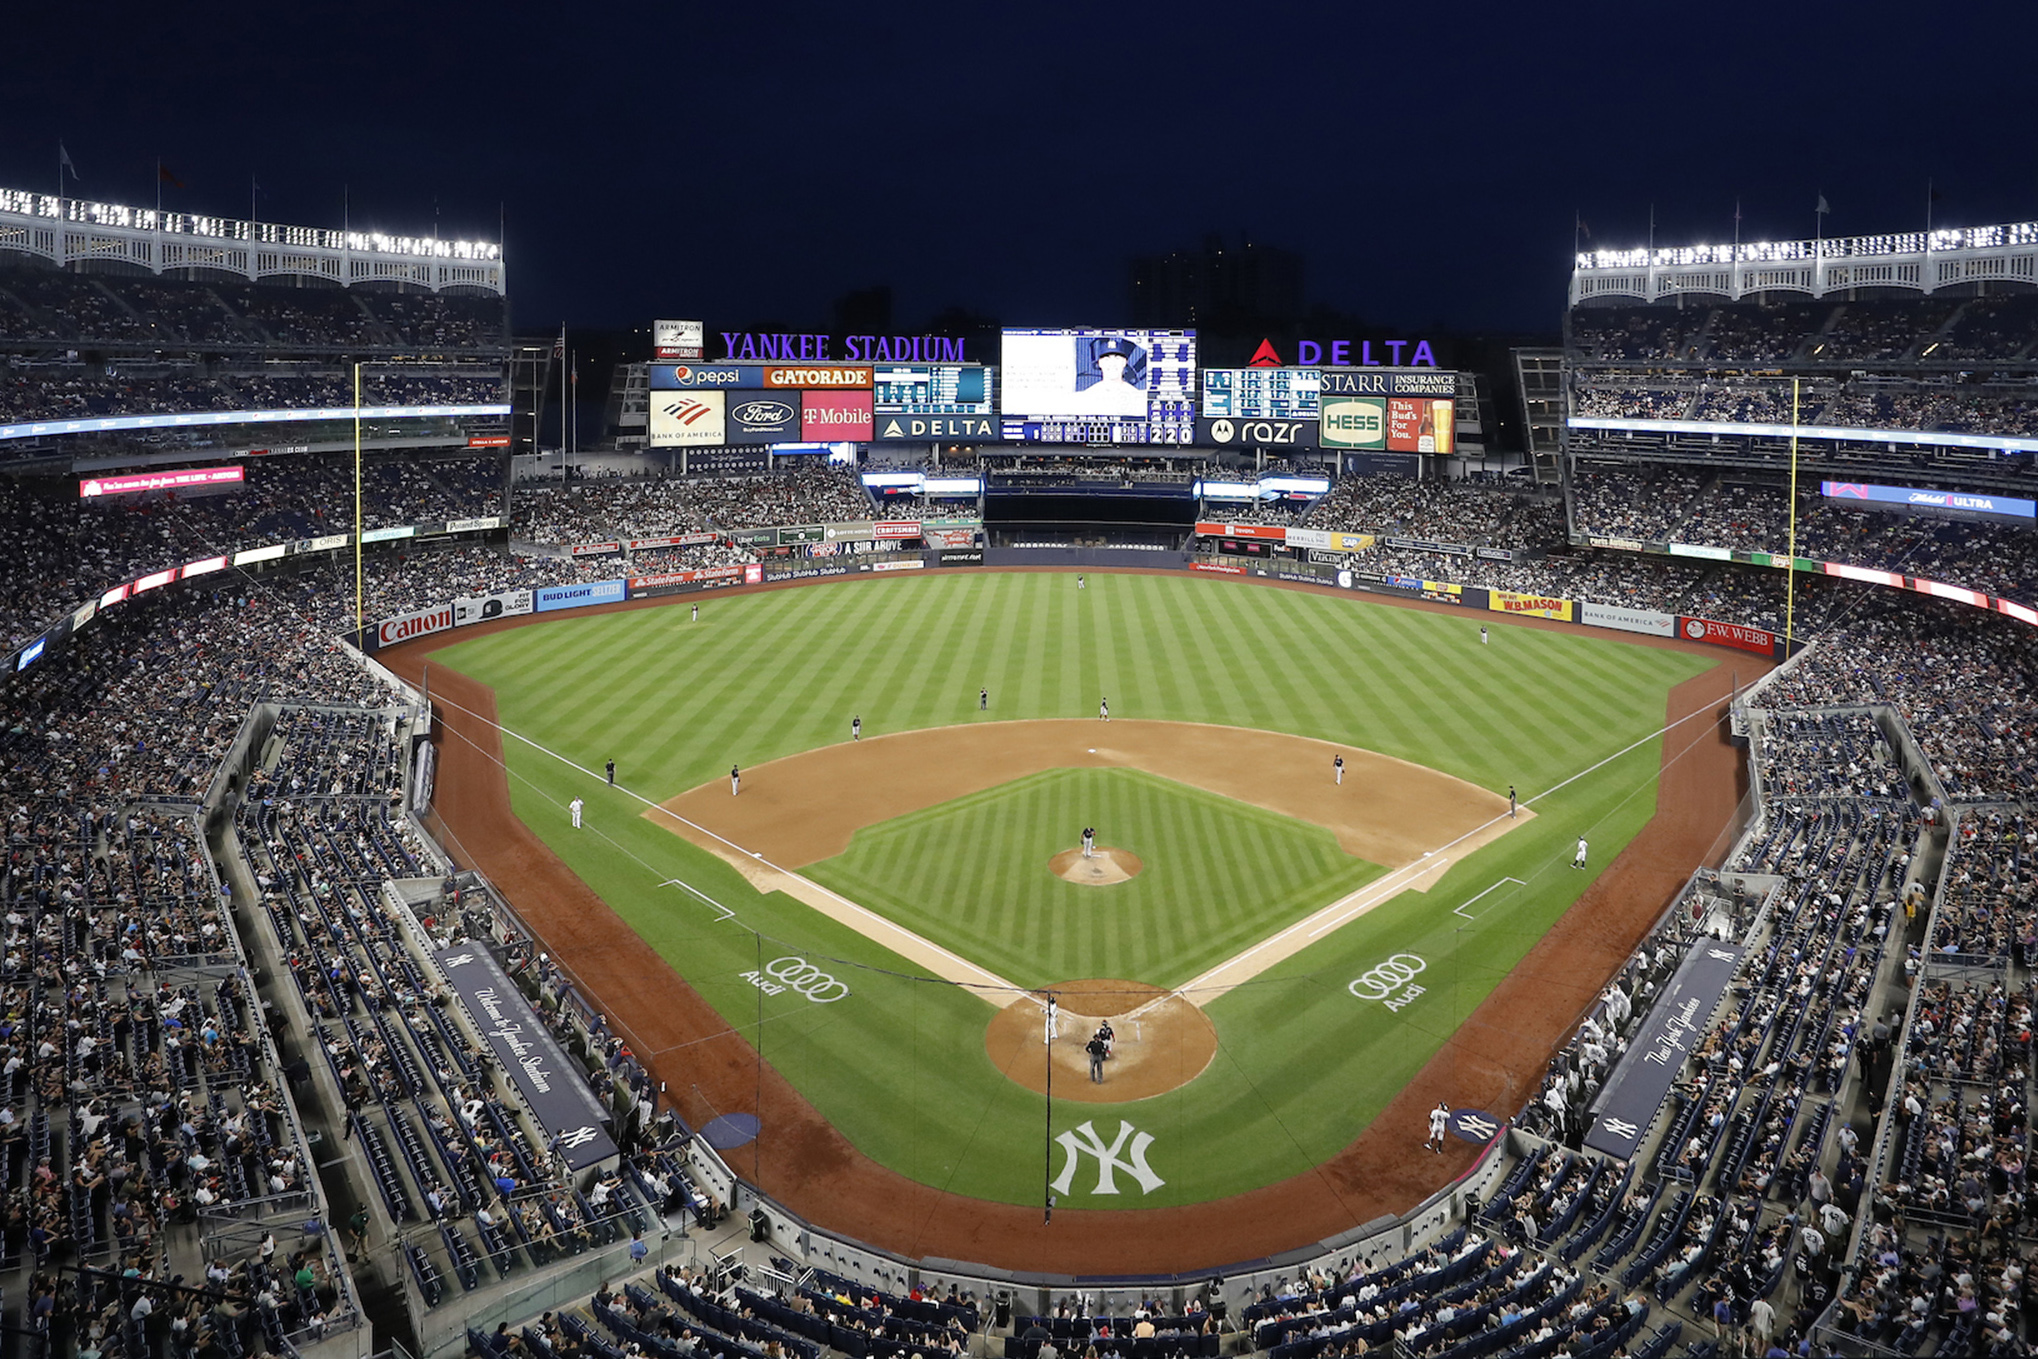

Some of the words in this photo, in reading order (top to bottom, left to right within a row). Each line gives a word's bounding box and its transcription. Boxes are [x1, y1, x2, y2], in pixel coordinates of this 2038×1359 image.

[660, 347, 700, 355] ARMITRON
[720, 332, 830, 360] YANKEE
[845, 335, 965, 362] STADIUM
[1298, 340, 1437, 367] DELTA
[696, 369, 741, 386] pepsi
[770, 370, 867, 385] GATORADE
[1320, 374, 1388, 393] STARR
[1394, 375, 1456, 385] INSURANCE
[1394, 384, 1456, 394] COMPANIES
[743, 404, 784, 422] Ford
[1390, 401, 1414, 411] This
[819, 408, 872, 424] Mobile
[1327, 414, 1379, 431] HESS
[1391, 411, 1418, 421] Bud's
[911, 420, 993, 436] DELTA
[1242, 422, 1304, 443] razr
[1391, 421, 1408, 430] For
[688, 431, 723, 439] AMERICA
[1390, 429, 1412, 439] You.
[1953, 497, 1994, 509] ULTRA
[449, 521, 474, 531] Poland
[474, 519, 497, 530] Spring
[876, 526, 918, 535] CRAFTSMAN
[319, 536, 342, 546] ORIS
[1287, 535, 1315, 543] MERRILL
[1342, 538, 1359, 547] SAP
[844, 541, 853, 555] A
[1274, 544, 1292, 552] FedEx
[646, 575, 684, 586] StateFarm
[703, 568, 739, 579] StateFarm
[767, 573, 792, 582] StubHub
[793, 569, 819, 578] StubHub
[820, 567, 847, 576] StubHub
[543, 591, 563, 601] BUD
[564, 590, 591, 599] LIGHT
[592, 583, 621, 596] SELTZER
[505, 603, 530, 611] GLORY
[1584, 611, 1605, 619] BANK
[1617, 616, 1654, 626] AMERICA
[380, 610, 451, 643] Canon
[1707, 623, 1729, 638] F.W.
[1732, 627, 1768, 646] WEBB
[739, 970, 787, 997] Audi
[1382, 982, 1427, 1013] Audi
[1667, 997, 1702, 1033] Yankees
[1655, 1022, 1687, 1053] York
[489, 1023, 534, 1057] Yankee
[518, 1056, 551, 1095] Stadium
[1806, 1232, 1818, 1244] 23
